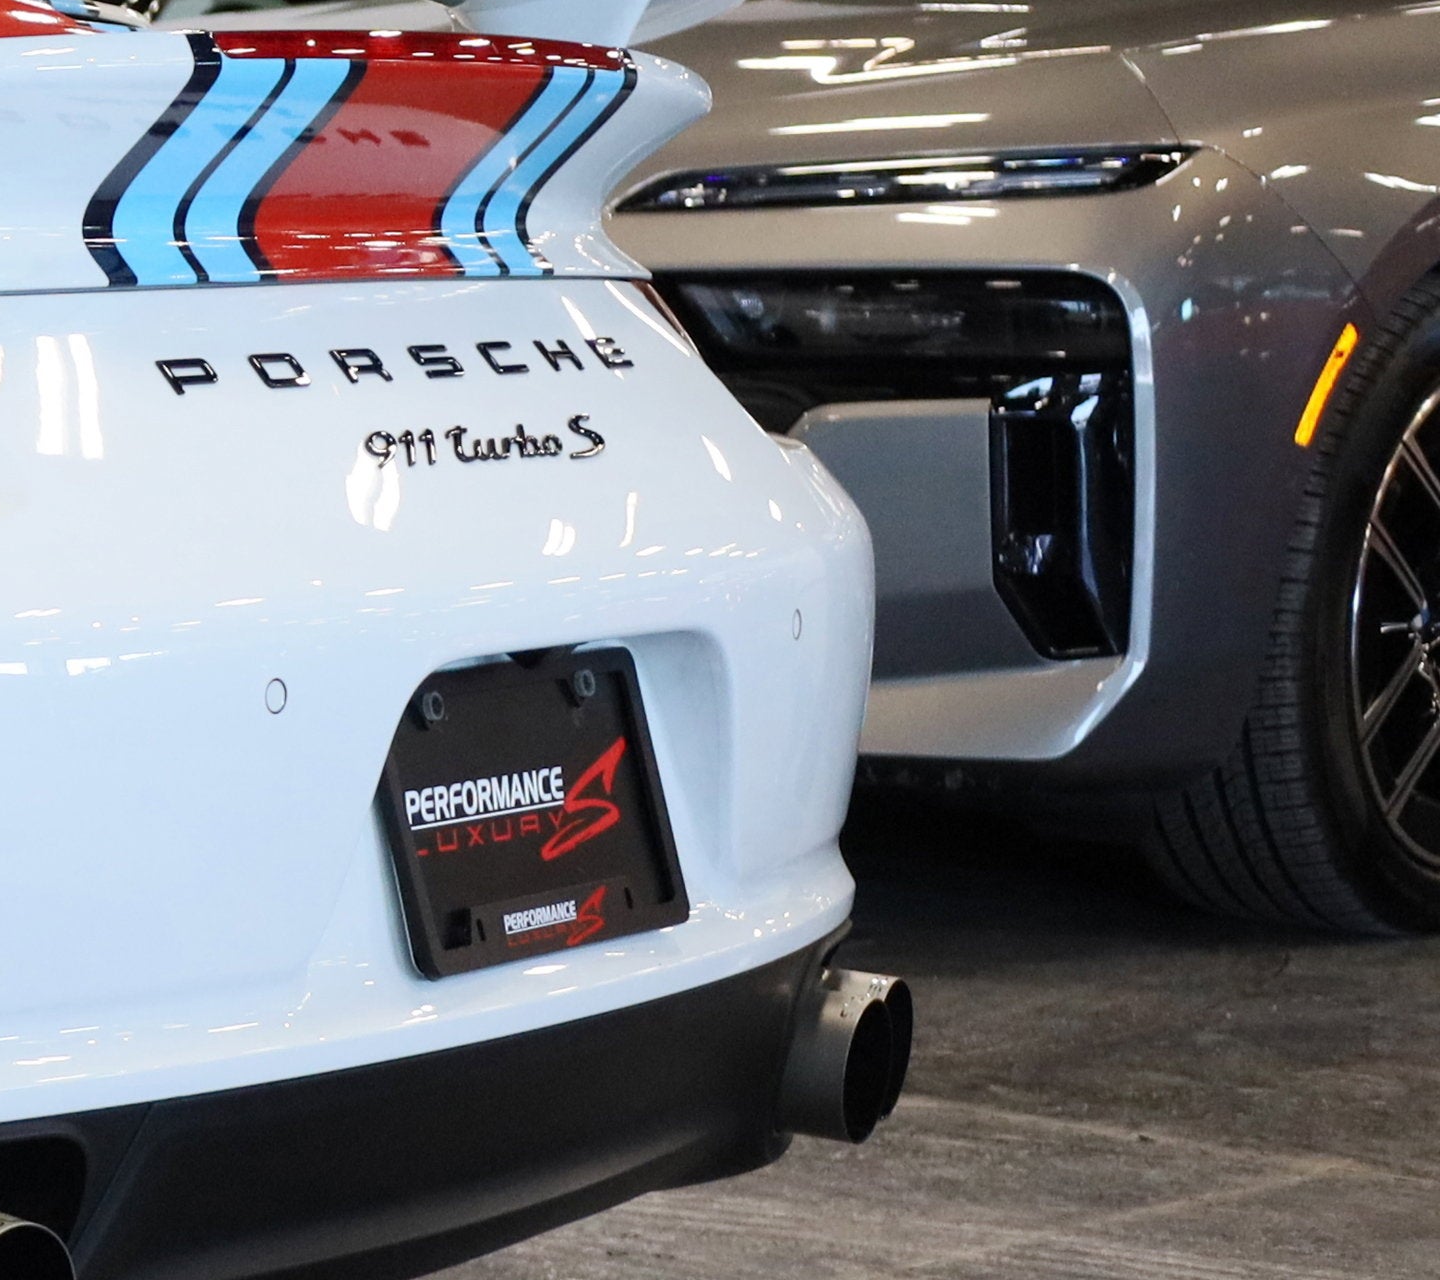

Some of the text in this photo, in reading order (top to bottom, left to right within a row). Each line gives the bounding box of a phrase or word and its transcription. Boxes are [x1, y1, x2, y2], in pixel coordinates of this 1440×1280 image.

[155, 336, 635, 396] PORSCHE
[364, 428, 437, 468] 911
[567, 412, 606, 461] S
[404, 765, 565, 825] PERFORMANCE
[503, 900, 577, 933] PERFORMANCE
